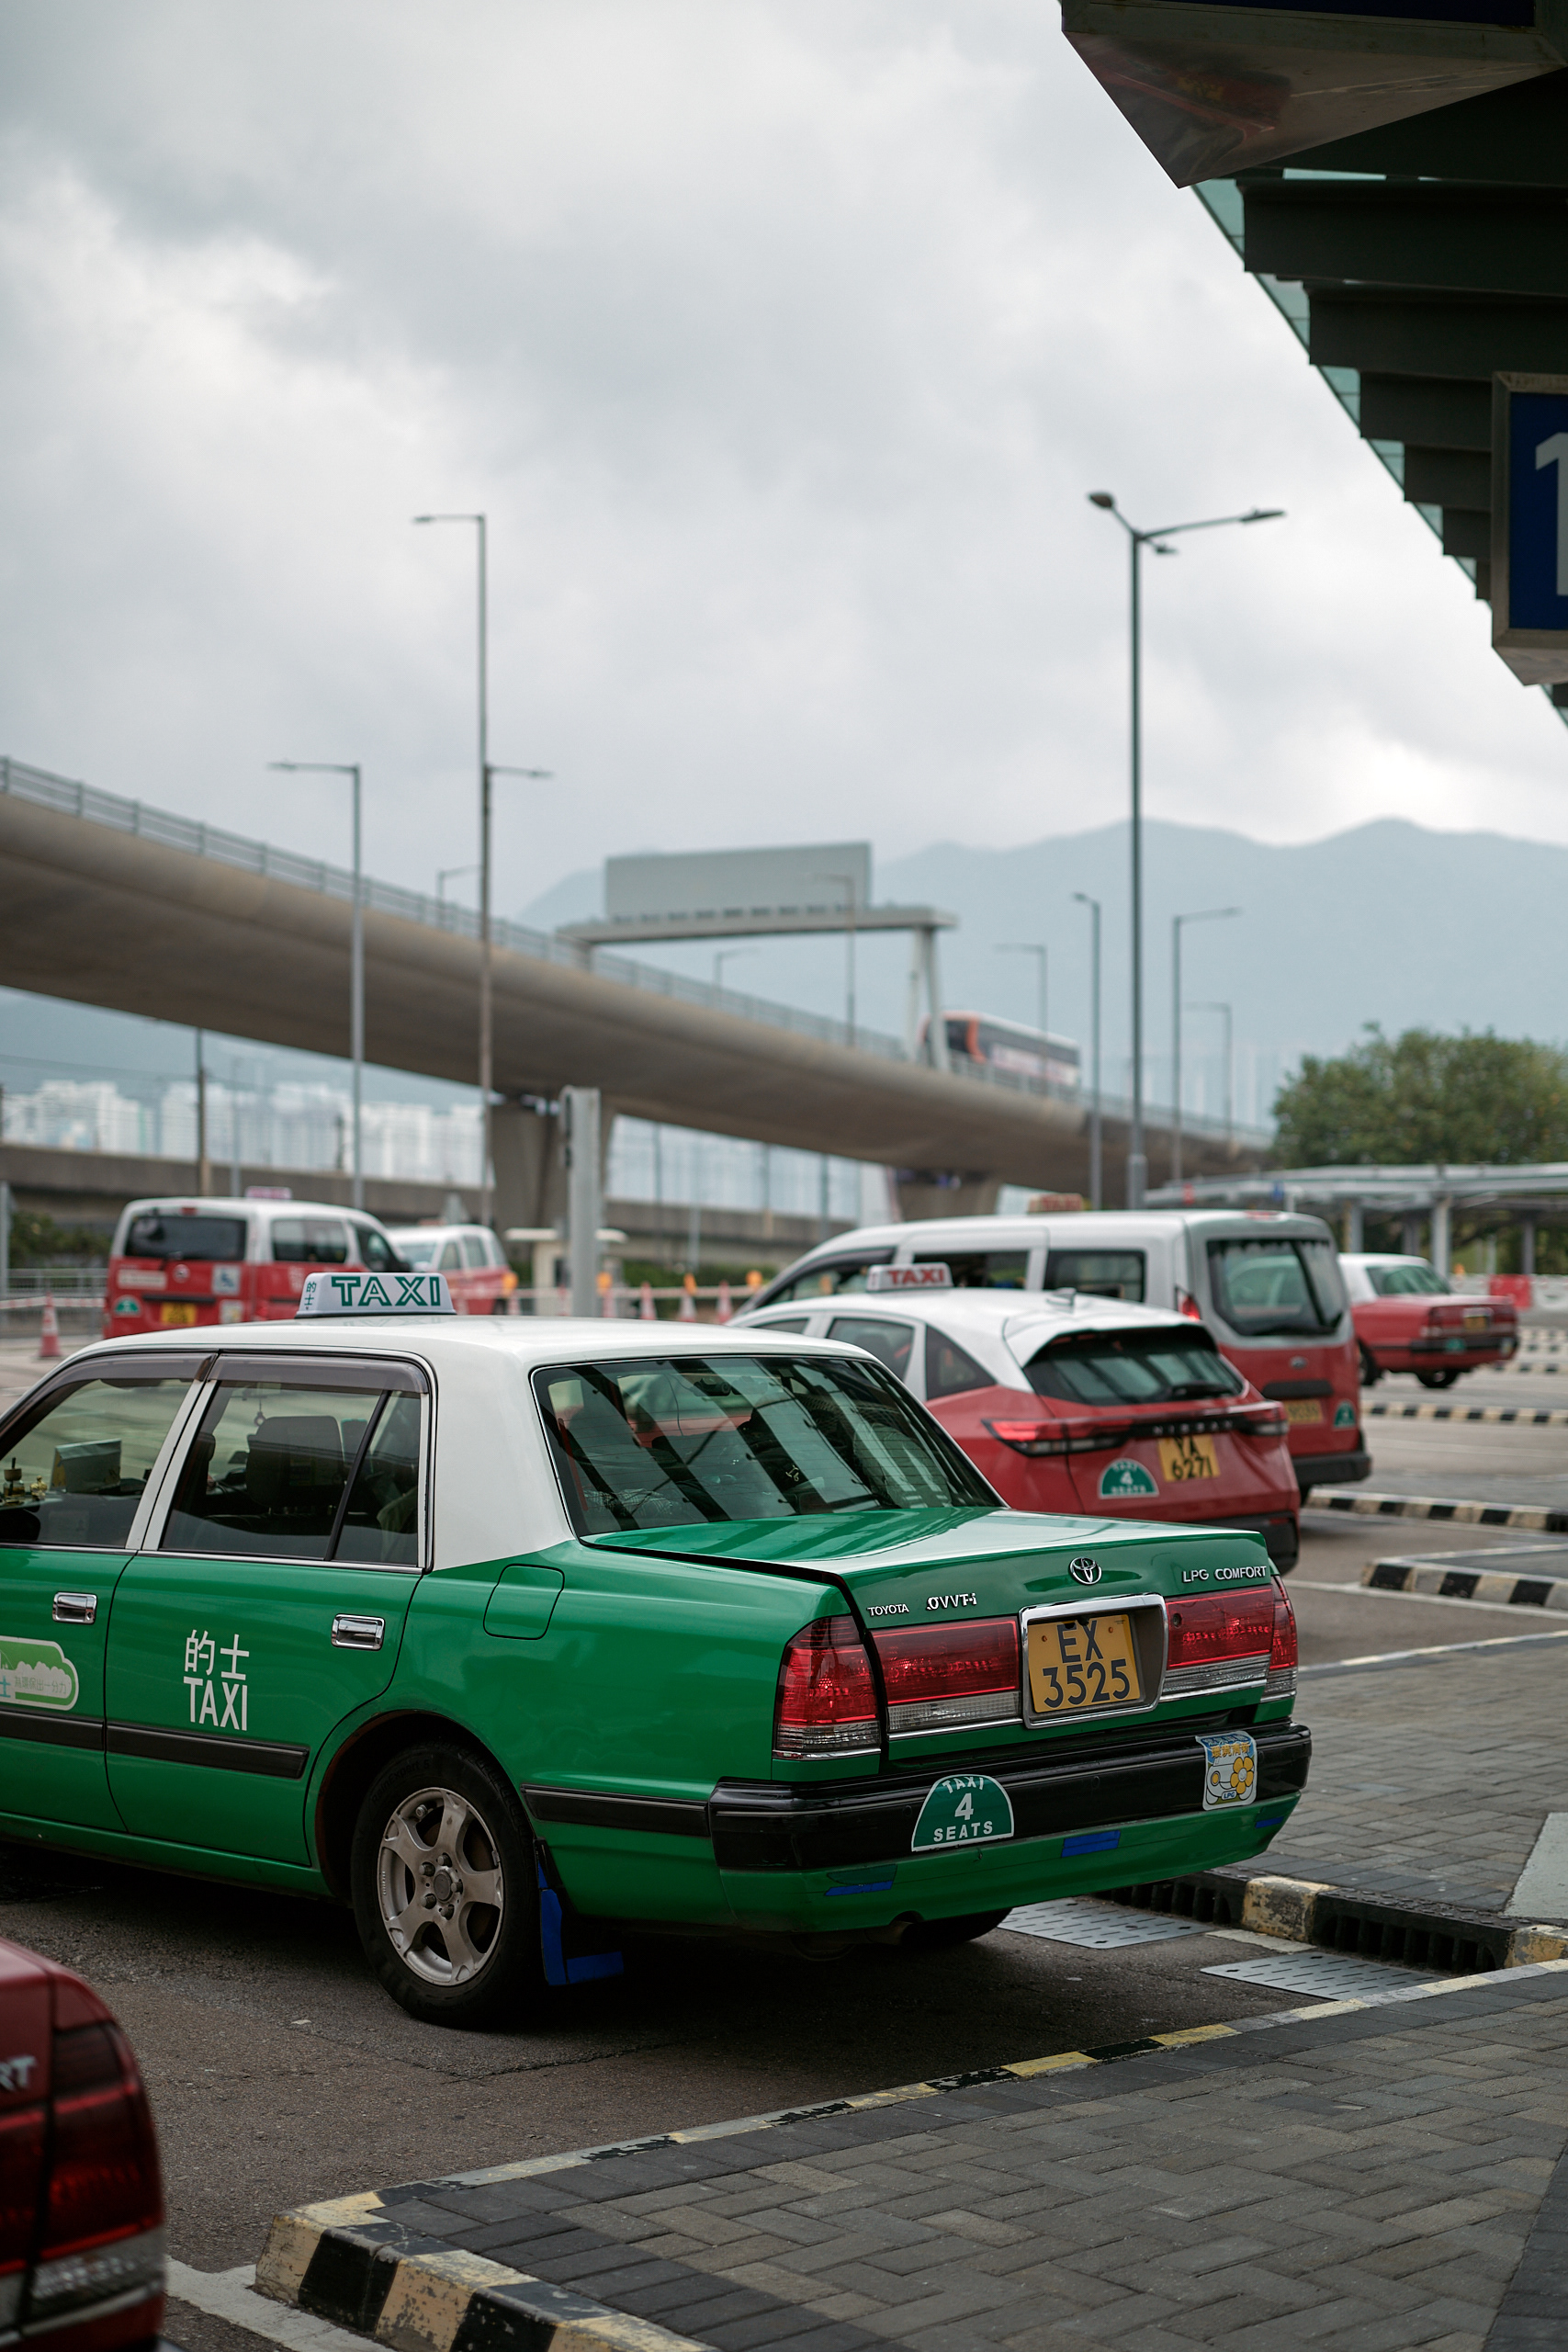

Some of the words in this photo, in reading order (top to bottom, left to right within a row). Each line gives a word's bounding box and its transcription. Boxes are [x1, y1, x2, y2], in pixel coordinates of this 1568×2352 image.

[888, 1268, 944, 1285] TAXI
[304, 1281, 317, 1306] 的士
[331, 1276, 441, 1306] TAXI
[1153, 1420, 1234, 1436] NISSAN
[1119, 1470, 1134, 1486] 4
[1171, 1456, 1213, 1480] 6271
[1182, 1568, 1210, 1583] LPG
[1214, 1566, 1267, 1580] COMFORT
[867, 1603, 909, 1617] TOYOTA
[1056, 1620, 1104, 1664] EX
[184, 1629, 250, 1681] 的士
[1043, 1658, 1131, 1709] 3525
[183, 1676, 248, 1731] TAXI
[942, 1776, 985, 1794] TAXI
[953, 1792, 975, 1821] 4
[933, 1820, 993, 1843] SEATS
